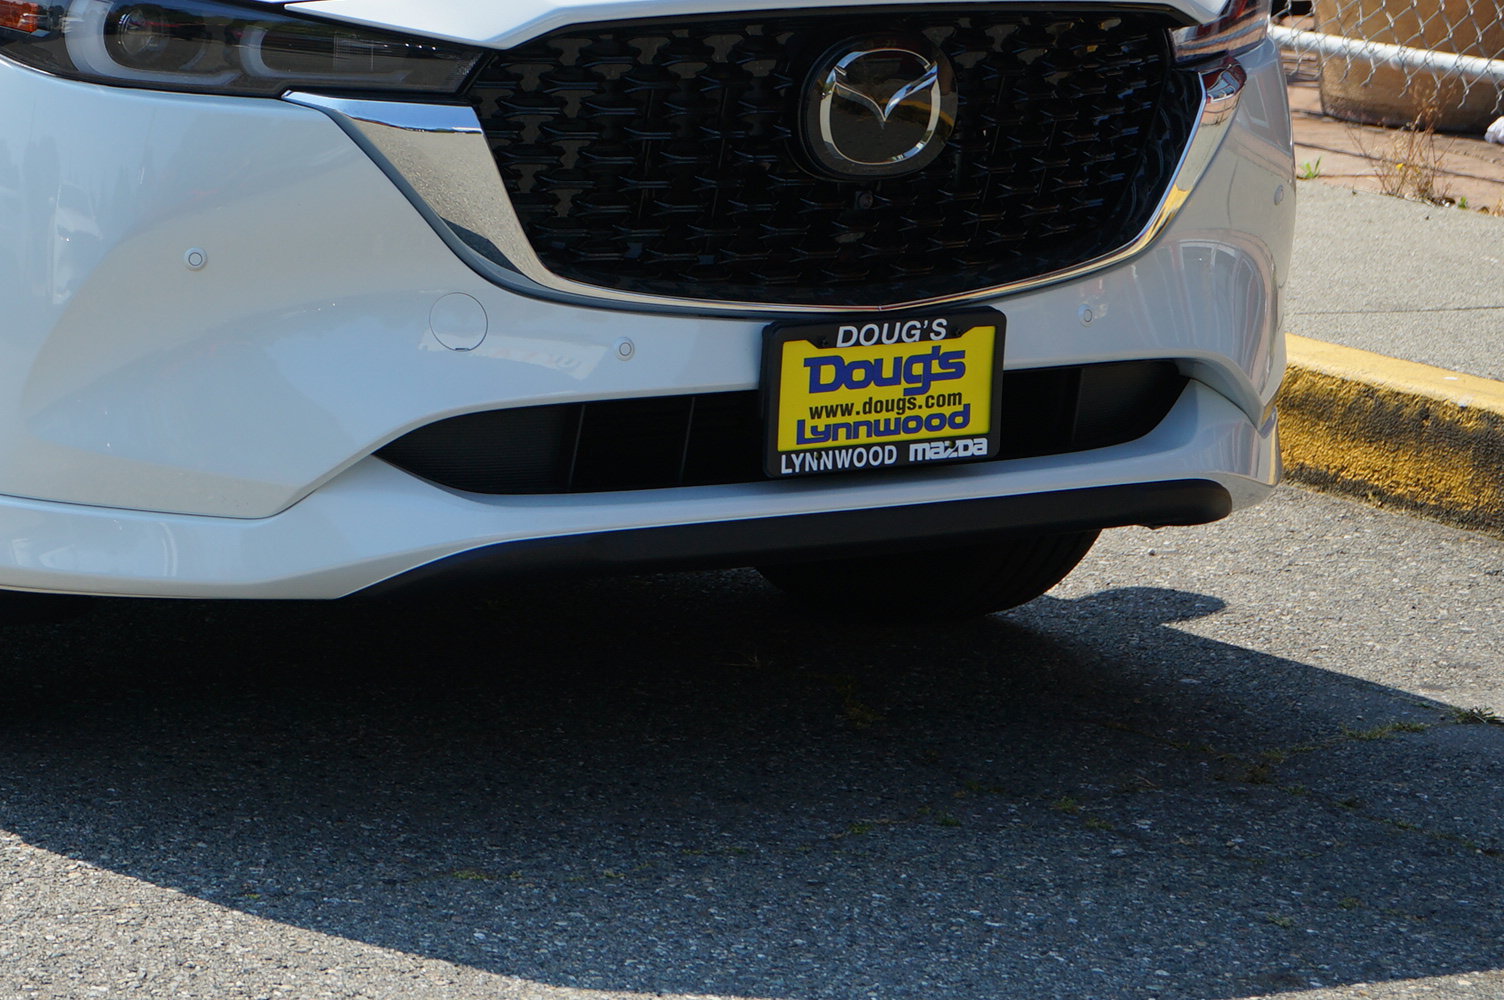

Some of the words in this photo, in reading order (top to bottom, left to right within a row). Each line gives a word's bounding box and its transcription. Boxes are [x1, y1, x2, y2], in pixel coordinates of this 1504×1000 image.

[836, 318, 947, 348] DOUG'S
[803, 345, 966, 397] Doug's
[808, 391, 963, 420] www.dougs.com
[796, 403, 971, 445] Lynnwood
[780, 445, 897, 475] LYNNWOOD
